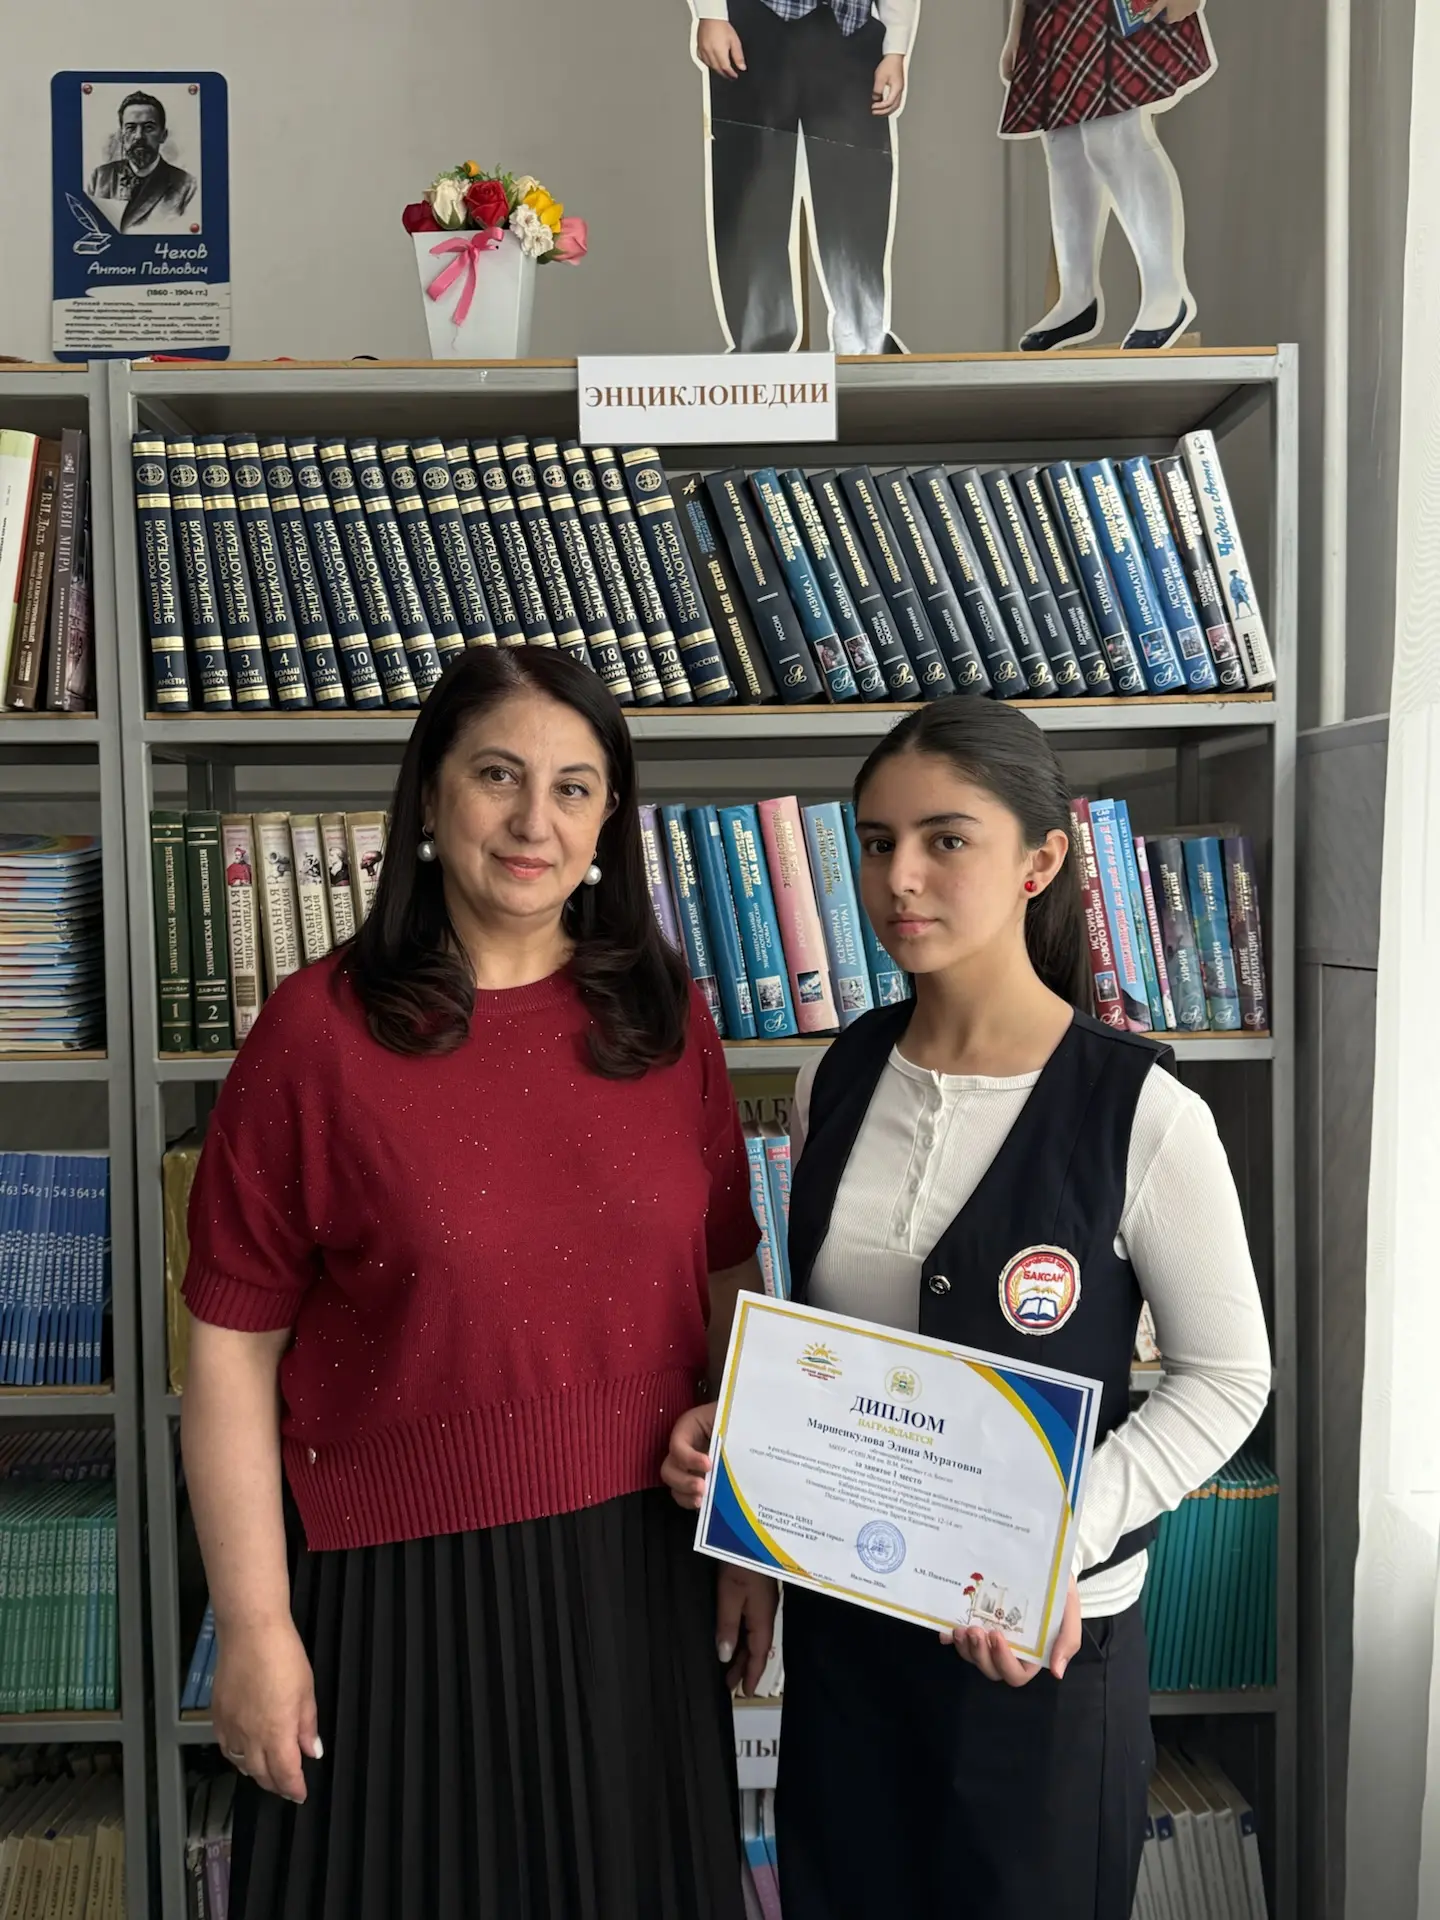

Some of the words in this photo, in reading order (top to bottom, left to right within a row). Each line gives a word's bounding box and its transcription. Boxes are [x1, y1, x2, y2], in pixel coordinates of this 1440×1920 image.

[88, 261, 136, 274] Антон
[140, 262, 208, 274] Павлович
[155, 243, 208, 259] Чехов
[585, 383, 829, 411] ЭНЦИКЛОПЕДИИ
[724, 480, 739, 504] ДЕТЕЙ
[1201, 459, 1220, 502] света
[60, 482, 76, 532] МУЗЕИ
[733, 505, 746, 522] ДЛЯ
[761, 483, 796, 562] ЭНЦИКЛОПЕДИЯ
[775, 493, 793, 524] ДЕТЕЙ
[792, 482, 826, 560] ЭНЦИКЛОПЕДИЯ
[1092, 474, 1125, 553] ЭНЦИКЛОПЕДИЯ
[1132, 470, 1164, 549] ЭНЦИКЛОПЕДИЯ
[1167, 470, 1196, 550] ЭНЦИКЛОПЕДИЯ
[787, 526, 802, 546] ДЛЯ
[1212, 506, 1236, 558] Чудеса
[58, 534, 72, 573] МИРА
[155, 520, 176, 624] ЭНЦИКЛОПЕДИЯ
[189, 520, 214, 624] ЭНЦИКЛОПЕДИЯ
[223, 520, 250, 624] ЭНЦИКЛОПЕДИЯ
[257, 520, 286, 622] ЭНЦИКЛОПЕДИЯ
[290, 520, 322, 622] ЭНЦИКЛОПЕДИЯ
[324, 520, 358, 622] ЭНЦИКЛОПЕДИЯ
[355, 520, 392, 622] ЭНЦИКЛОПЕДИЯ
[387, 521, 423, 623] ЭНЦИКЛОПЕДИЯ
[538, 518, 576, 619] ЭНЦИКЛОПЕДИЯ
[570, 518, 607, 620] ЭНЦИКЛОПЕДИЯ
[598, 522, 637, 622] ЭНЦИКЛОПЕДИЯ
[627, 521, 666, 620] ЭНЦИКЛОПЕДИЯ
[662, 521, 700, 620] ЭНЦИКЛОПЕДИЯ
[740, 524, 766, 586] ЭНЦИКЛОПЕДИЯ
[840, 525, 869, 587] ЭНЦИКЛОПЕДИЯ
[872, 521, 901, 584] ЭНЦИКЛОПЕДИЯ
[1168, 552, 1182, 577] ВЕКОВ
[708, 560, 726, 592] ДЕТЕЙ
[1094, 571, 1112, 616] ТЕХНИКА
[1124, 554, 1153, 626] ИНФОРМАТИКА
[1162, 568, 1180, 609] ИСТОРИЯ
[1194, 570, 1208, 607] ТОЛКОВЫЙ
[1202, 571, 1214, 602] СЛОВАРЬ
[720, 594, 734, 613] ДЛЯ
[803, 580, 822, 618] ФИЗИКА
[832, 581, 852, 619] ФИЗИКА
[1177, 579, 1192, 620] СРЕДНИХ
[772, 615, 786, 641] РОССИЯ
[871, 617, 887, 646] ИСТОРИЯ
[878, 618, 894, 645] РОССИИ
[906, 607, 924, 642] ГЕОГРАФИЯ
[942, 609, 960, 643] БИОЛОГИЯ
[1010, 607, 1030, 646] КОМПЬЮТЕР
[1044, 614, 1058, 638] БИЗНЕС
[1068, 607, 1086, 646] ДОМАШНИЕ
[1077, 607, 1092, 640] ПИТОМЦЫ
[164, 655, 172, 668] 1
[205, 654, 214, 668] 2
[241, 654, 250, 668] 3
[280, 652, 290, 666] 4
[316, 652, 326, 667] 6
[350, 652, 368, 667] 10
[384, 652, 400, 667] 11
[415, 652, 433, 668] 12
[569, 647, 586, 661] 17
[600, 648, 618, 664] 18
[630, 649, 647, 664] 19
[658, 649, 678, 664] 20
[689, 656, 720, 670] РОССИЯ
[728, 617, 761, 696] ЭНЦИКЛОПЕДИЯ
[647, 830, 660, 861] ДЕТЕЙ
[745, 830, 758, 860] ДЕТЕЙ
[772, 810, 792, 888] ЭНЦИКЛОПЕДИЯ
[1080, 822, 1096, 856] ДЕТЕЙ
[654, 863, 662, 886] ДЛЯ
[668, 820, 690, 898] ЭНЦИКЛОПЕДИЯ
[732, 820, 754, 898] ЭНЦИКЛОПЕДИЯ
[752, 862, 762, 886] ДЛЯ
[1087, 858, 1098, 878] ДЛЯ
[164, 846, 176, 913] ЭНЦИКЛОПЕДИЯ
[200, 848, 212, 916] ЭНЦИКЛОПЕДИЯ
[270, 888, 286, 968] ШКОЛЬНАЯ
[282, 888, 298, 968] ЭНЦИКЛОПЕДИЯ
[688, 902, 699, 924] ЯЗЫК
[1092, 889, 1107, 928] ВРЕМЕНИ
[169, 917, 180, 974] ХИМИЧЕСКАЯ
[204, 920, 215, 976] ХИМИЧЕСКАЯ
[230, 888, 244, 970] ШКОЛЬНАЯ
[242, 890, 254, 970] ЭНЦИКЛОПЕДИЯ
[693, 925, 708, 968] РУССКИЙ
[748, 912, 762, 962] УНИВЕРСАЛЬНЫЙ
[753, 902, 770, 968] ЭНЦИКЛОПЕДИЧЕСКИЙ
[764, 921, 774, 948] СЛОВАРЬ
[830, 909, 846, 964] ВСЕМИРНАЯ
[841, 909, 856, 966] ЛИТЕРАТУРА
[1085, 908, 1098, 950] ИСТОРИЯ
[1099, 930, 1112, 966] НОВОГО
[1178, 950, 1192, 983] ХИМИЯ
[1213, 942, 1227, 990] БИОЛОГИЯ
[1239, 948, 1252, 986] ДРЕВНИЕ
[1248, 932, 1264, 1001] ЦИВИЛИЗАЦИИ
[172, 1004, 179, 1018] 1
[208, 1005, 218, 1020] 2
[1024, 1270, 1064, 1282] БАКСАН
[850, 1396, 946, 1435] ДИПЛОМ
[858, 1418, 934, 1446] НАГРАЖДАЕТСЯ
[805, 1417, 885, 1449] Маршенкулова
[886, 1440, 921, 1457] Элина
[921, 1450, 983, 1477] Муратовна
[898, 1473, 922, 1485] место
